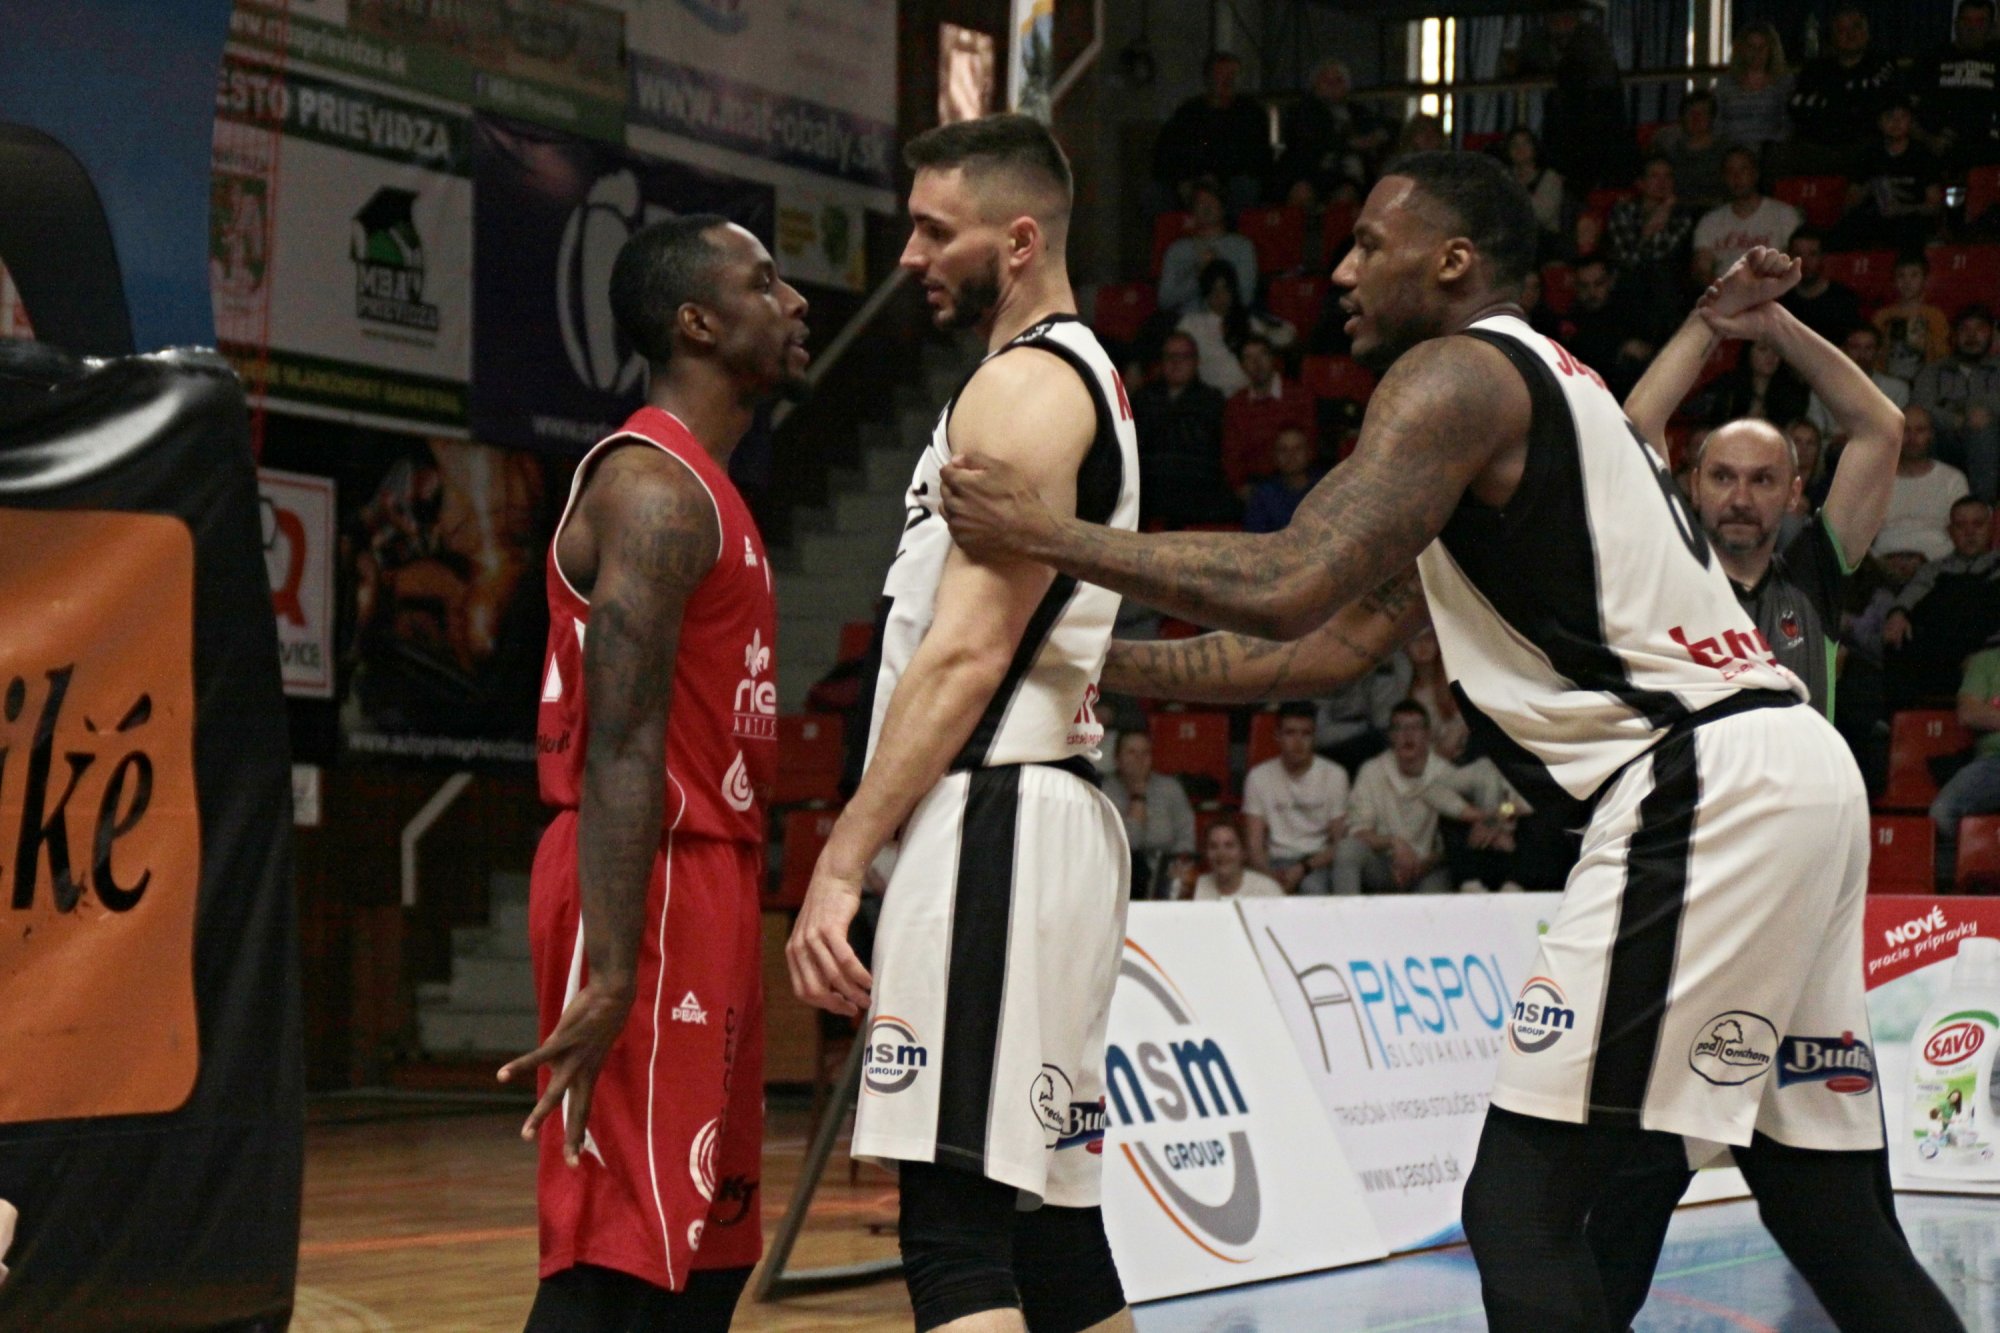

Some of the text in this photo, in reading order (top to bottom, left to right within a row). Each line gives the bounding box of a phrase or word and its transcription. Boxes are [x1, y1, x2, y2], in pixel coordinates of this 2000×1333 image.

[298, 87, 451, 160] PRIEVIDZA
[1885, 904, 1947, 948] NOVÉ
[1868, 947, 1910, 976] pracie
[672, 1007, 708, 1025] PEAK
[1518, 1025, 1545, 1037] GROUP
[1386, 1034, 1505, 1068] SLOVAKIA MA
[1931, 1024, 1980, 1061] SAVO
[869, 1067, 903, 1076] GROUP
[1163, 1139, 1225, 1171] GROUP
[1358, 1152, 1465, 1195] www.paspol.sk
